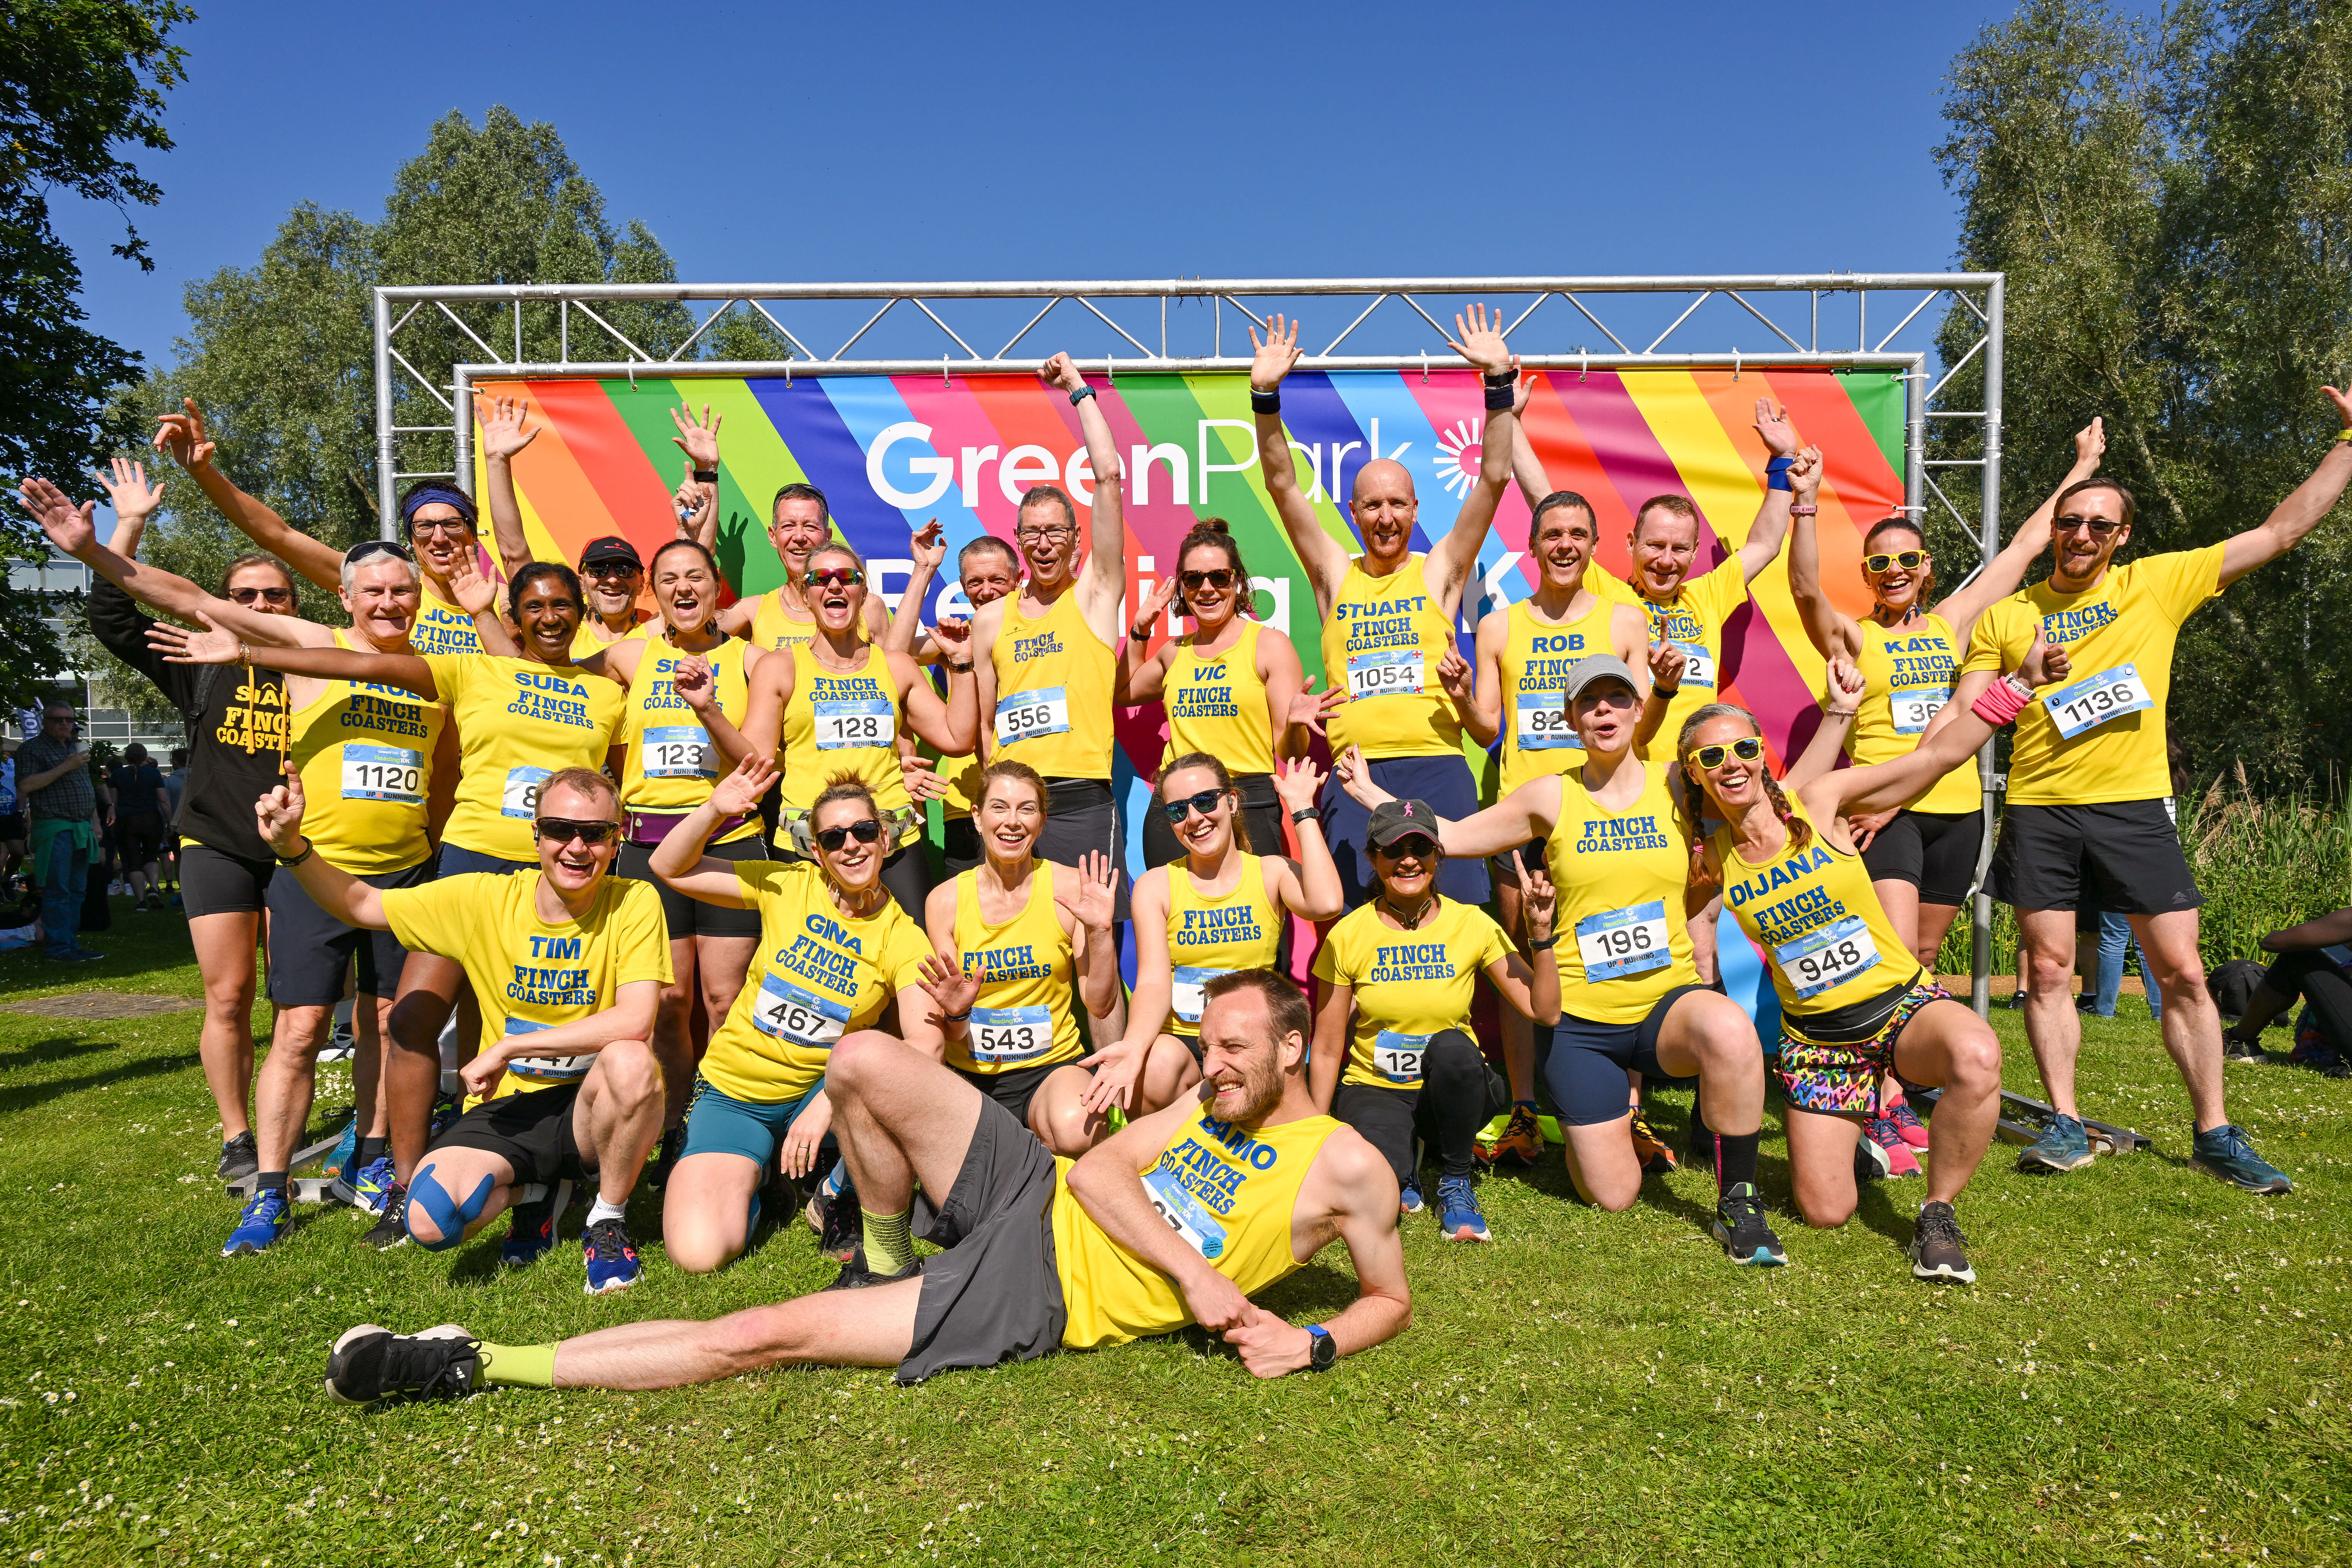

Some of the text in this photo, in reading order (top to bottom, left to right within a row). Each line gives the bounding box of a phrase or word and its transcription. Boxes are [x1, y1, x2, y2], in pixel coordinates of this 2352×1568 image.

[425, 609, 473, 627] JON
[1337, 596, 1426, 620] STUART
[2043, 601, 2108, 630] FINCH
[414, 623, 477, 647] FINCH
[1351, 617, 1412, 637] FINCH
[2044, 608, 2118, 643] OASTERS
[776, 637, 811, 646] FIN
[1014, 631, 1055, 652] FINCH
[1346, 633, 1419, 652] COASTERS
[1533, 634, 1585, 653] ROB
[1884, 638, 1950, 654] KATE
[1014, 643, 1063, 662] COASTERS
[1195, 665, 1226, 681] VIC
[1525, 658, 1586, 676] FINC
[1893, 656, 1956, 672] FINCH
[515, 673, 590, 699] SUBA
[814, 678, 879, 691] FINCH
[1355, 667, 1414, 688] 1054
[1519, 677, 1566, 691] COAST
[1890, 671, 1961, 687] COASTERS
[517, 690, 586, 717] FINCH
[809, 691, 887, 702] COASTERS
[1178, 687, 1232, 704] FINCH
[2064, 684, 2133, 722] 1136
[349, 694, 422, 722] FINCH
[507, 703, 594, 729] COASTERS
[1008, 705, 1051, 732] 556
[1172, 704, 1238, 718] COASTERS
[1909, 703, 1946, 722] 36
[2101, 705, 2134, 720] RUNNING
[224, 707, 291, 734] FINC
[341, 712, 427, 738] COASTERS
[833, 717, 877, 738] 128
[1532, 711, 1570, 731] 82
[217, 727, 291, 751] COASTE
[1026, 727, 1052, 737] RUNNING
[658, 744, 702, 765] 123
[356, 765, 418, 791] 1120
[384, 792, 413, 801] RUNNING
[1584, 816, 1657, 838] FINCH
[1577, 835, 1668, 853] COASTERS
[1729, 846, 1834, 907] DIJANA
[1184, 906, 1253, 929] FINCH
[1753, 885, 1831, 931] FINCH
[1760, 900, 1845, 945] COASTERS
[806, 914, 861, 955] GINA
[1177, 925, 1261, 945] COASTERS
[1597, 926, 1650, 956] 196
[530, 936, 581, 959] TIM
[790, 934, 857, 979] FINCH
[963, 945, 1034, 971] FINCH
[1377, 944, 1446, 966] FINCH
[1624, 953, 1654, 964] RUNNING
[1799, 941, 1860, 981] 948
[514, 965, 589, 990] FINCH
[776, 949, 858, 997] COASTERS
[964, 964, 1051, 984] CASTERS
[1372, 964, 1455, 982] COASTERS
[1834, 965, 1865, 985] RUNNING
[507, 983, 596, 1005] COASTERS
[768, 1004, 826, 1036] 467
[783, 1032, 816, 1046] RUNNING
[982, 1027, 1034, 1050] 543
[1386, 1053, 1424, 1072] 12
[1172, 1138, 1247, 1196] FINCH
[1160, 1151, 1236, 1214] COASTERS
